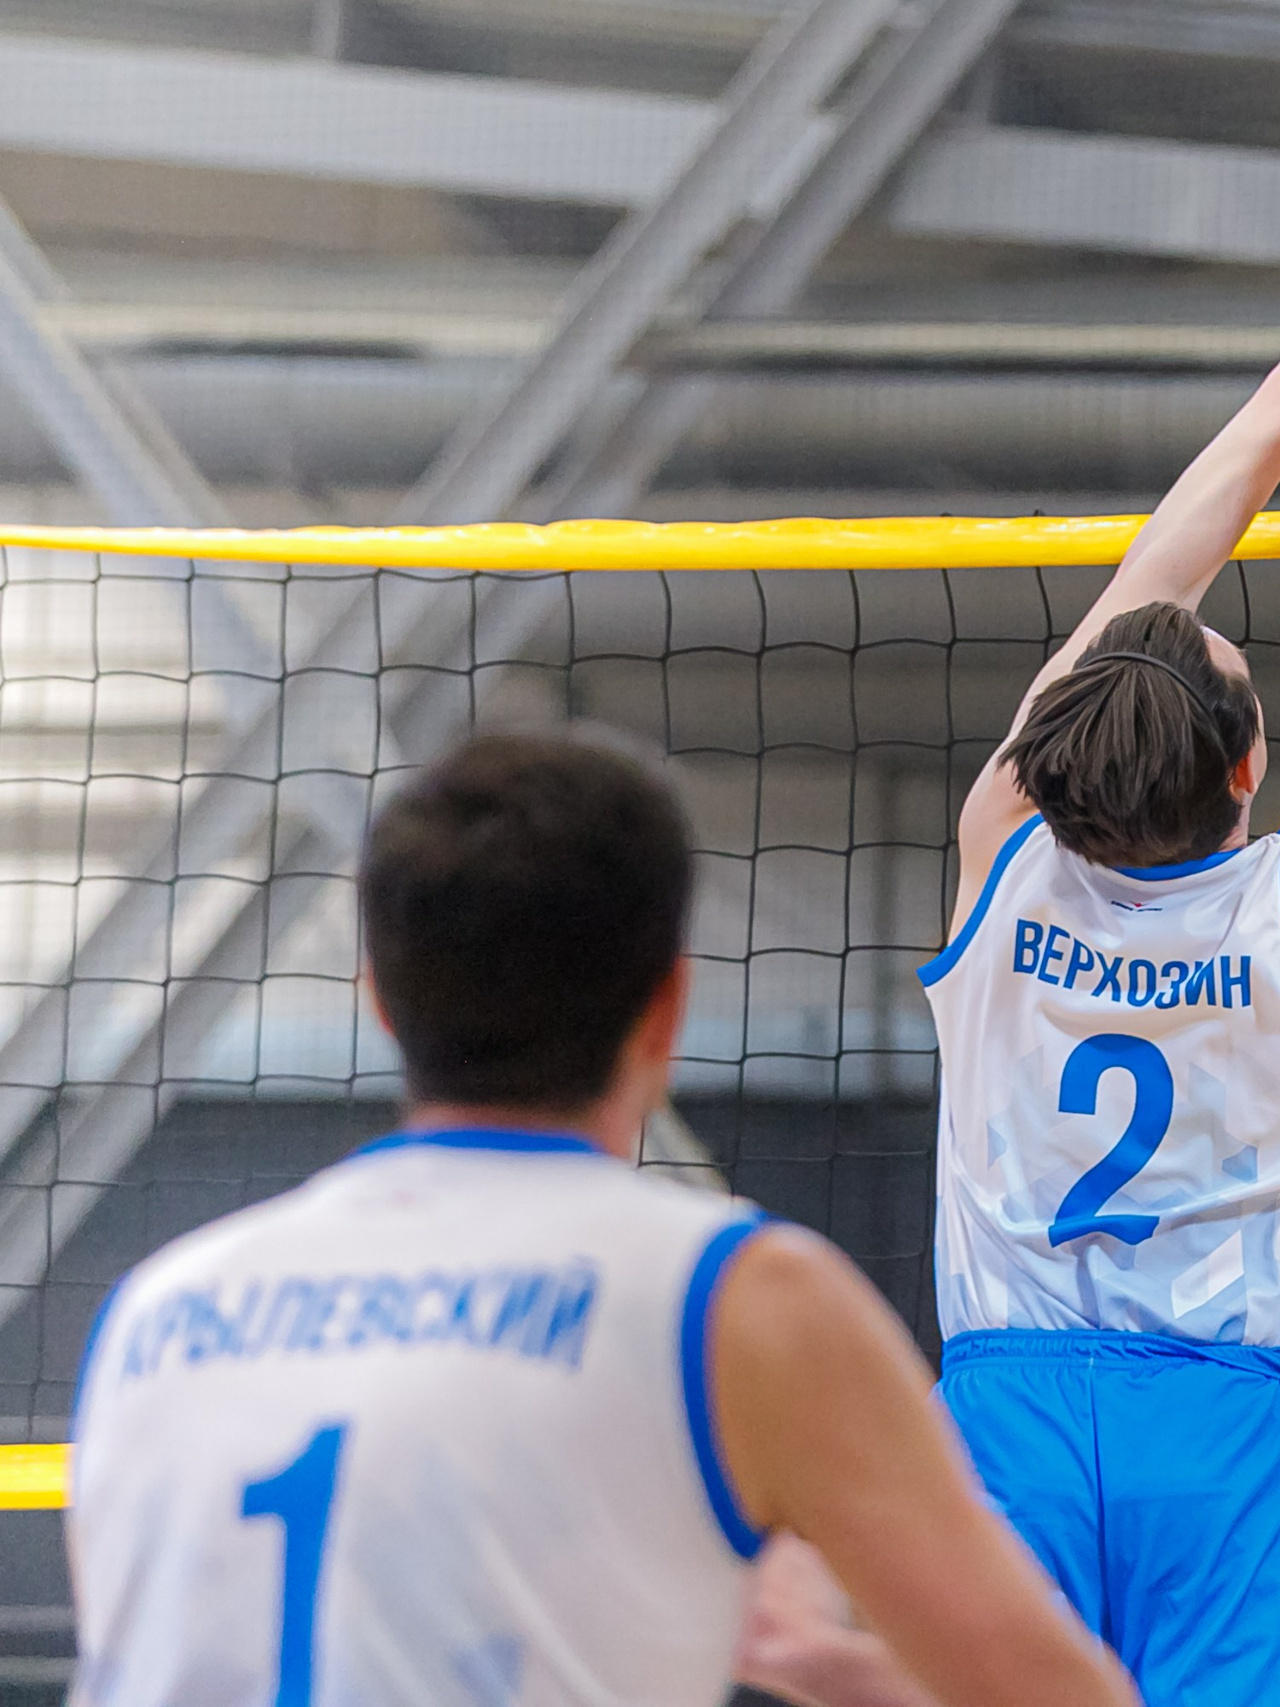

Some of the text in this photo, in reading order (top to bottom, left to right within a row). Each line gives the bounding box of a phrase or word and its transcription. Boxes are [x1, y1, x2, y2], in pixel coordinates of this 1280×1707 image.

[1013, 918, 1252, 1010] ВЕРХОЗИН
[1048, 1033, 1174, 1248] 2
[242, 1423, 348, 1707] 1
